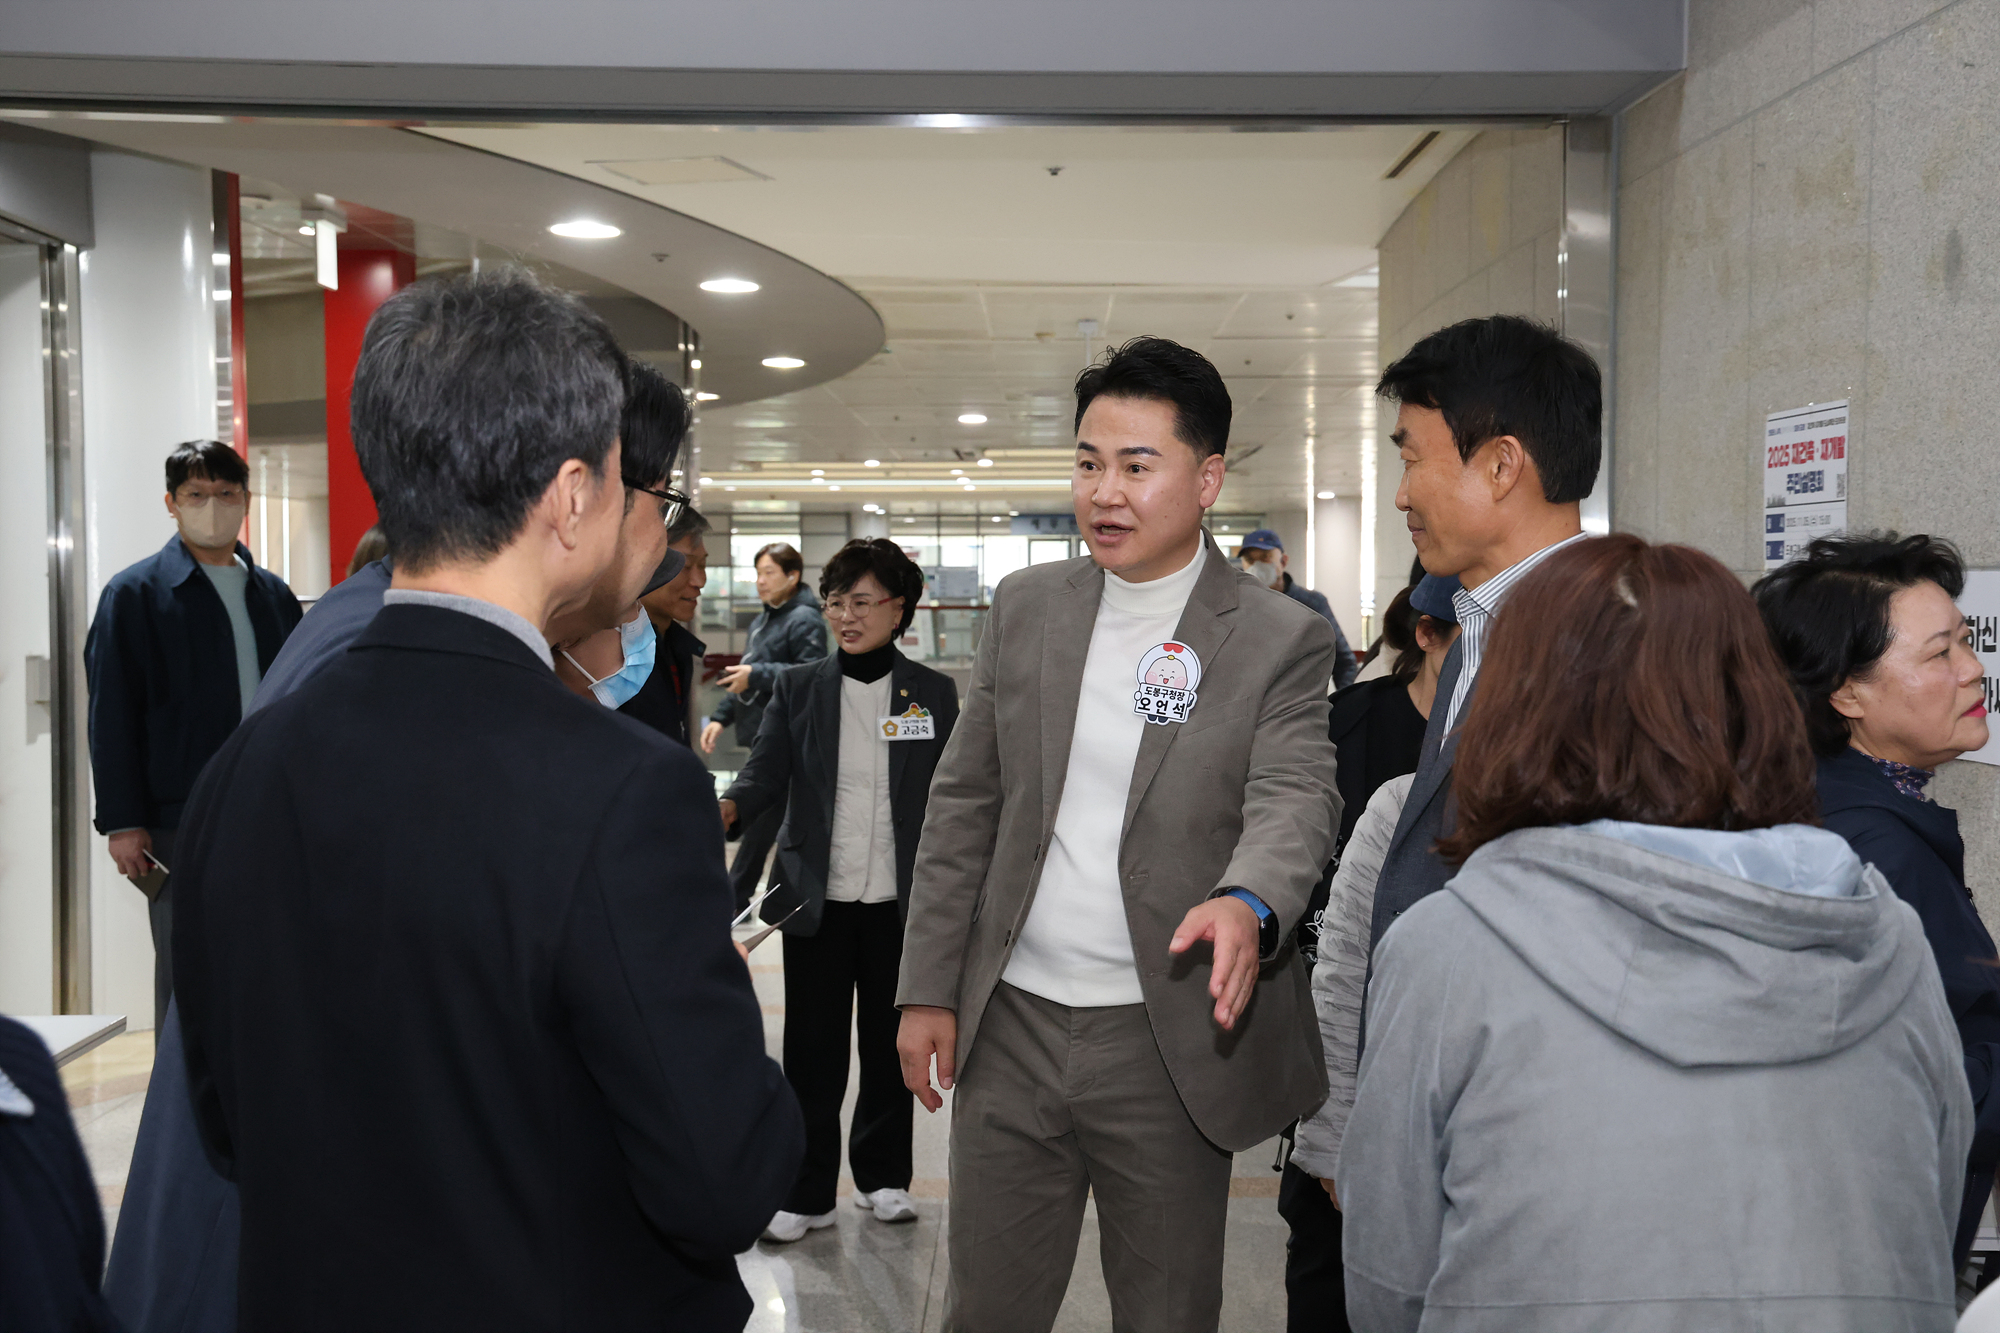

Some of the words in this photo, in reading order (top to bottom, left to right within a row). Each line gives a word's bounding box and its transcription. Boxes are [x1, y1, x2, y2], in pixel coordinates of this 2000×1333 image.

[1767, 444, 1790, 468] 2025
[1792, 440, 1815, 464] 재건축
[1820, 435, 1846, 460] 재개발
[1786, 470, 1824, 494] 주민설명회
[1144, 686, 1185, 701] 도봉구청장
[901, 725, 929, 735] 고금숙
